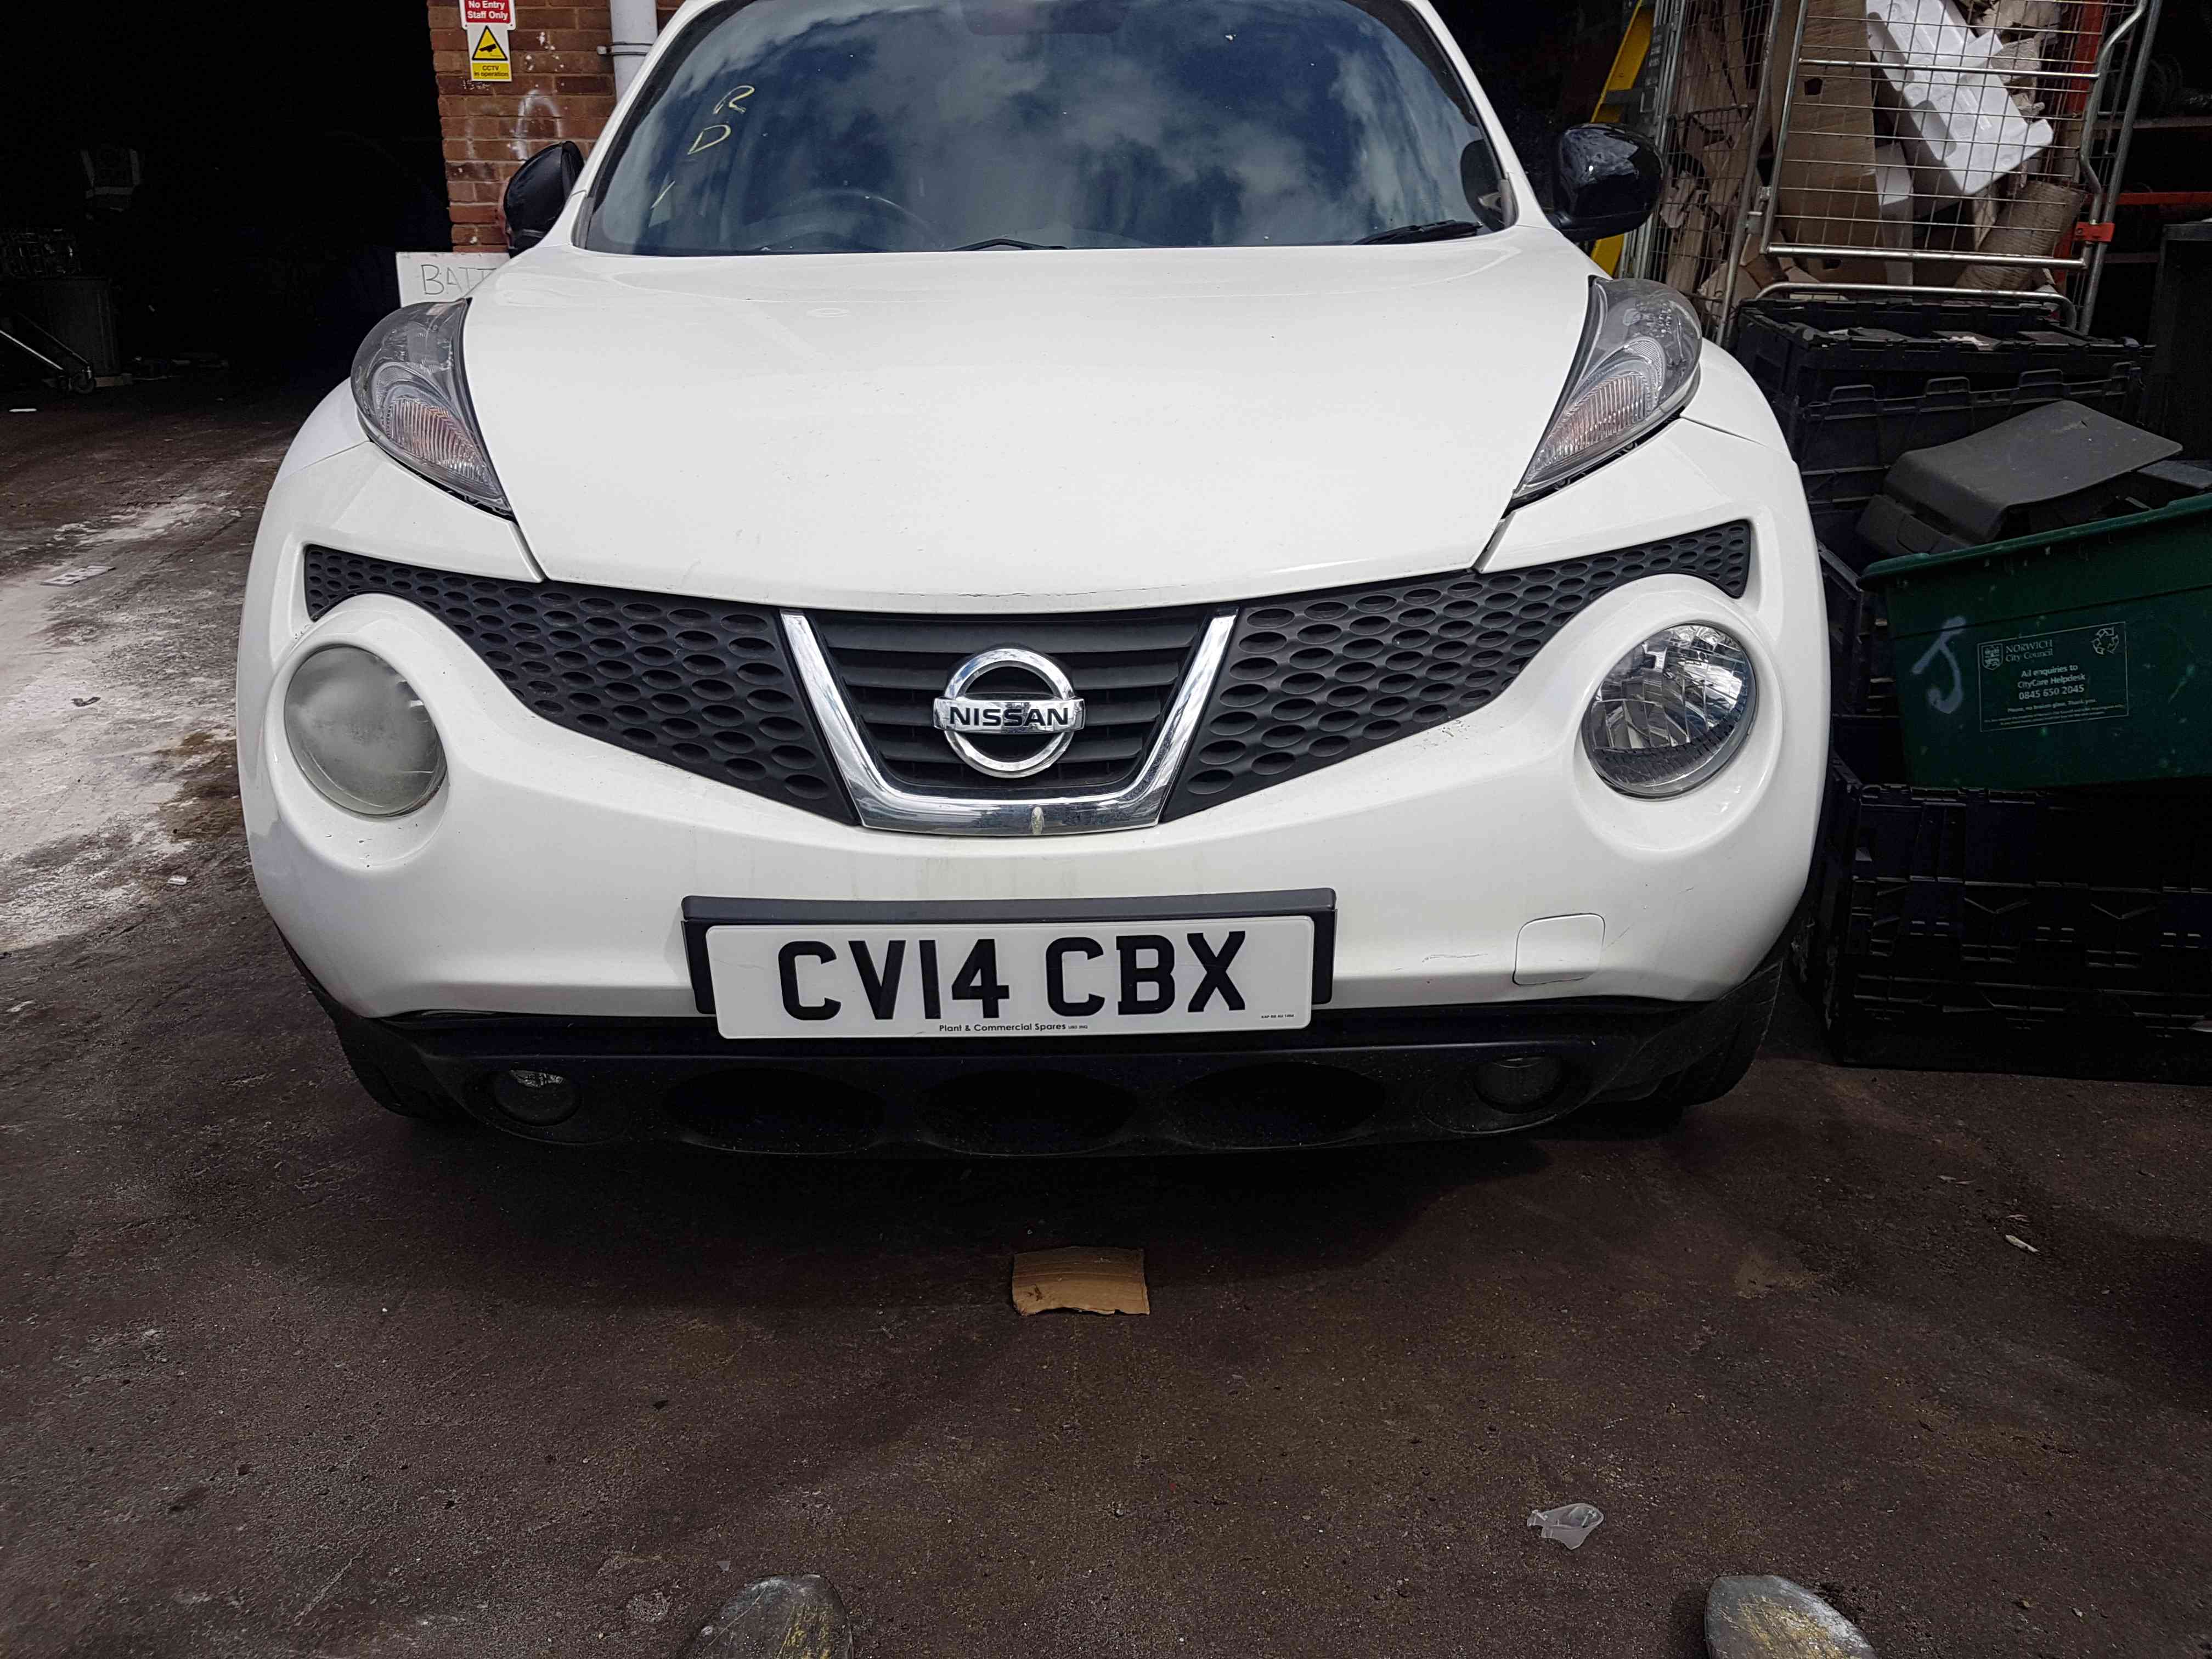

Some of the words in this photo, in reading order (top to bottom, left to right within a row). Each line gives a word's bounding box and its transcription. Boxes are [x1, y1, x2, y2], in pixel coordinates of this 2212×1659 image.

[482, 1, 505, 10] Entry
[488, 11, 509, 20] Only
[713, 84, 755, 115] R
[687, 123, 732, 156] D
[2005, 639, 2053, 653] NORWICH
[2005, 653, 2021, 663] City
[2024, 648, 2054, 660] Council
[2021, 669, 2032, 678] All
[2033, 665, 2068, 676] enquiries
[2017, 679, 2049, 689] CityCare
[2050, 673, 2085, 685] Helpdesk
[2018, 690, 2041, 701] 0845
[2042, 687, 2060, 697] 650
[2061, 684, 2085, 695] 2045
[949, 706, 1069, 726] NISSAN
[776, 938, 1010, 1022] CV14
[1044, 930, 1248, 1017] CBX
[974, 1023, 1032, 1032] Commercial
[1035, 1023, 1066, 1032] Spares
